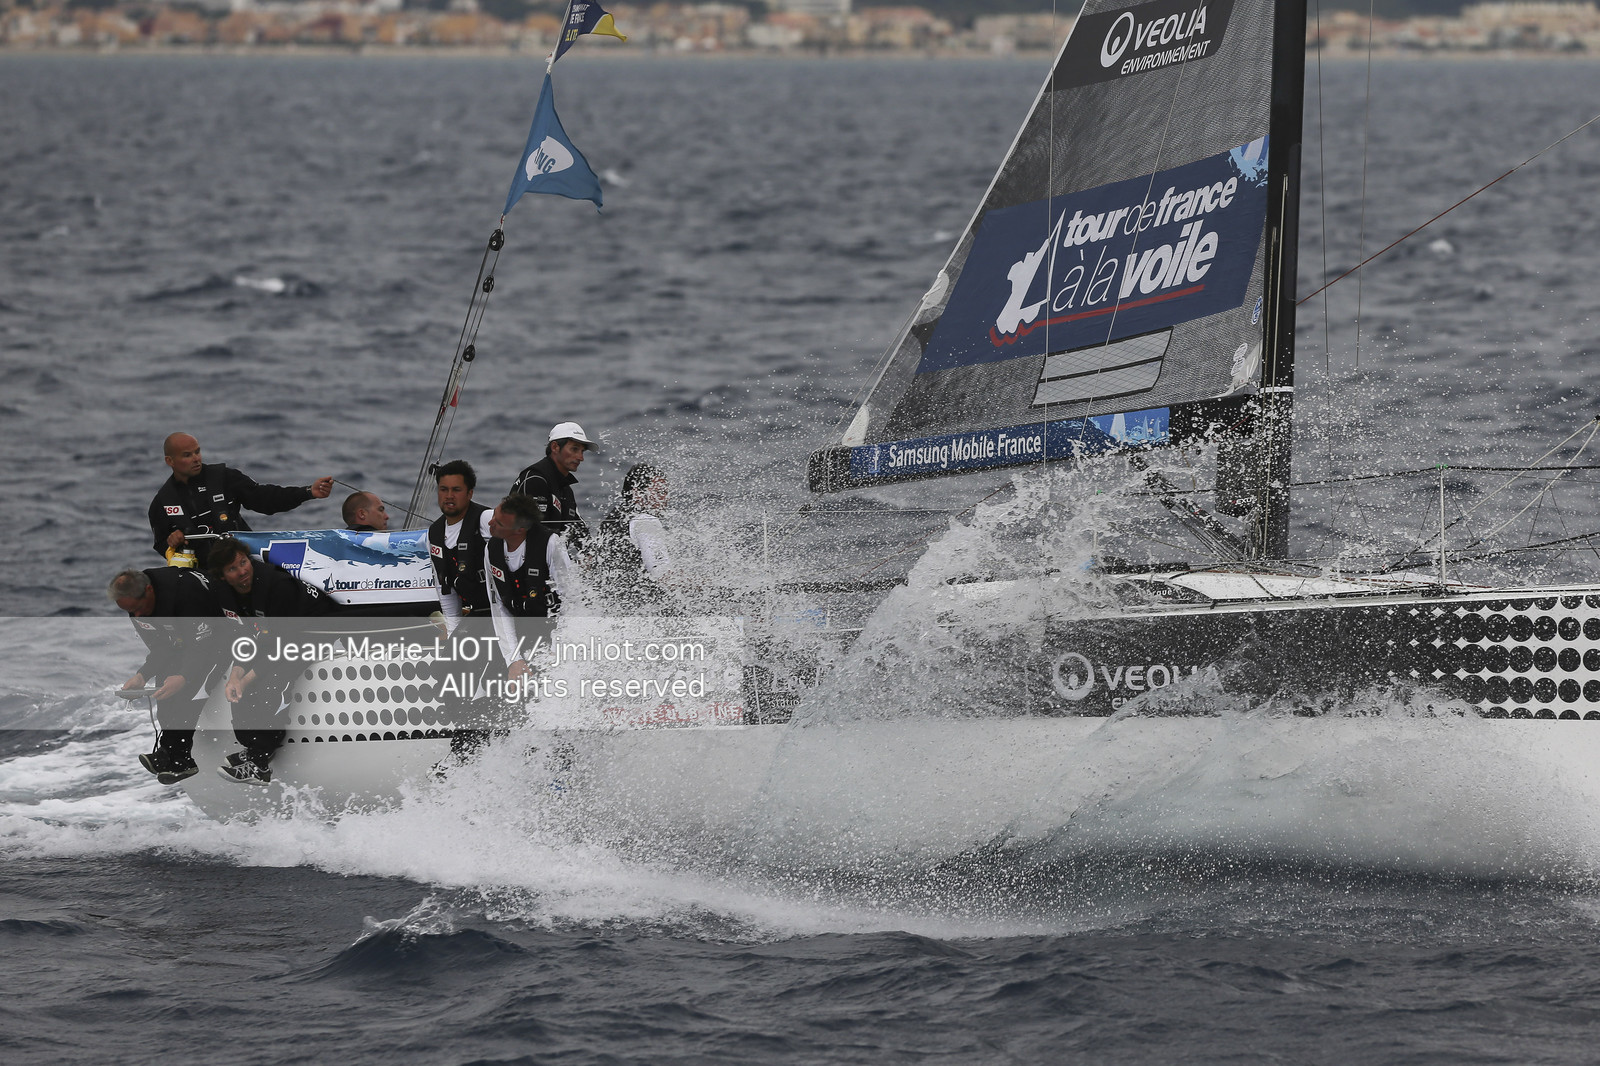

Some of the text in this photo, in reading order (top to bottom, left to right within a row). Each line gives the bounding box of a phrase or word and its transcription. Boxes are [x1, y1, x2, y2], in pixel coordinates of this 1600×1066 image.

[1134, 6, 1207, 51] VEOLIA
[1121, 40, 1211, 75] ENVIRONNEMENT
[1118, 220, 1219, 299] voile
[888, 444, 948, 469] Samsung
[951, 436, 994, 462] Mobile
[997, 433, 1042, 457] France
